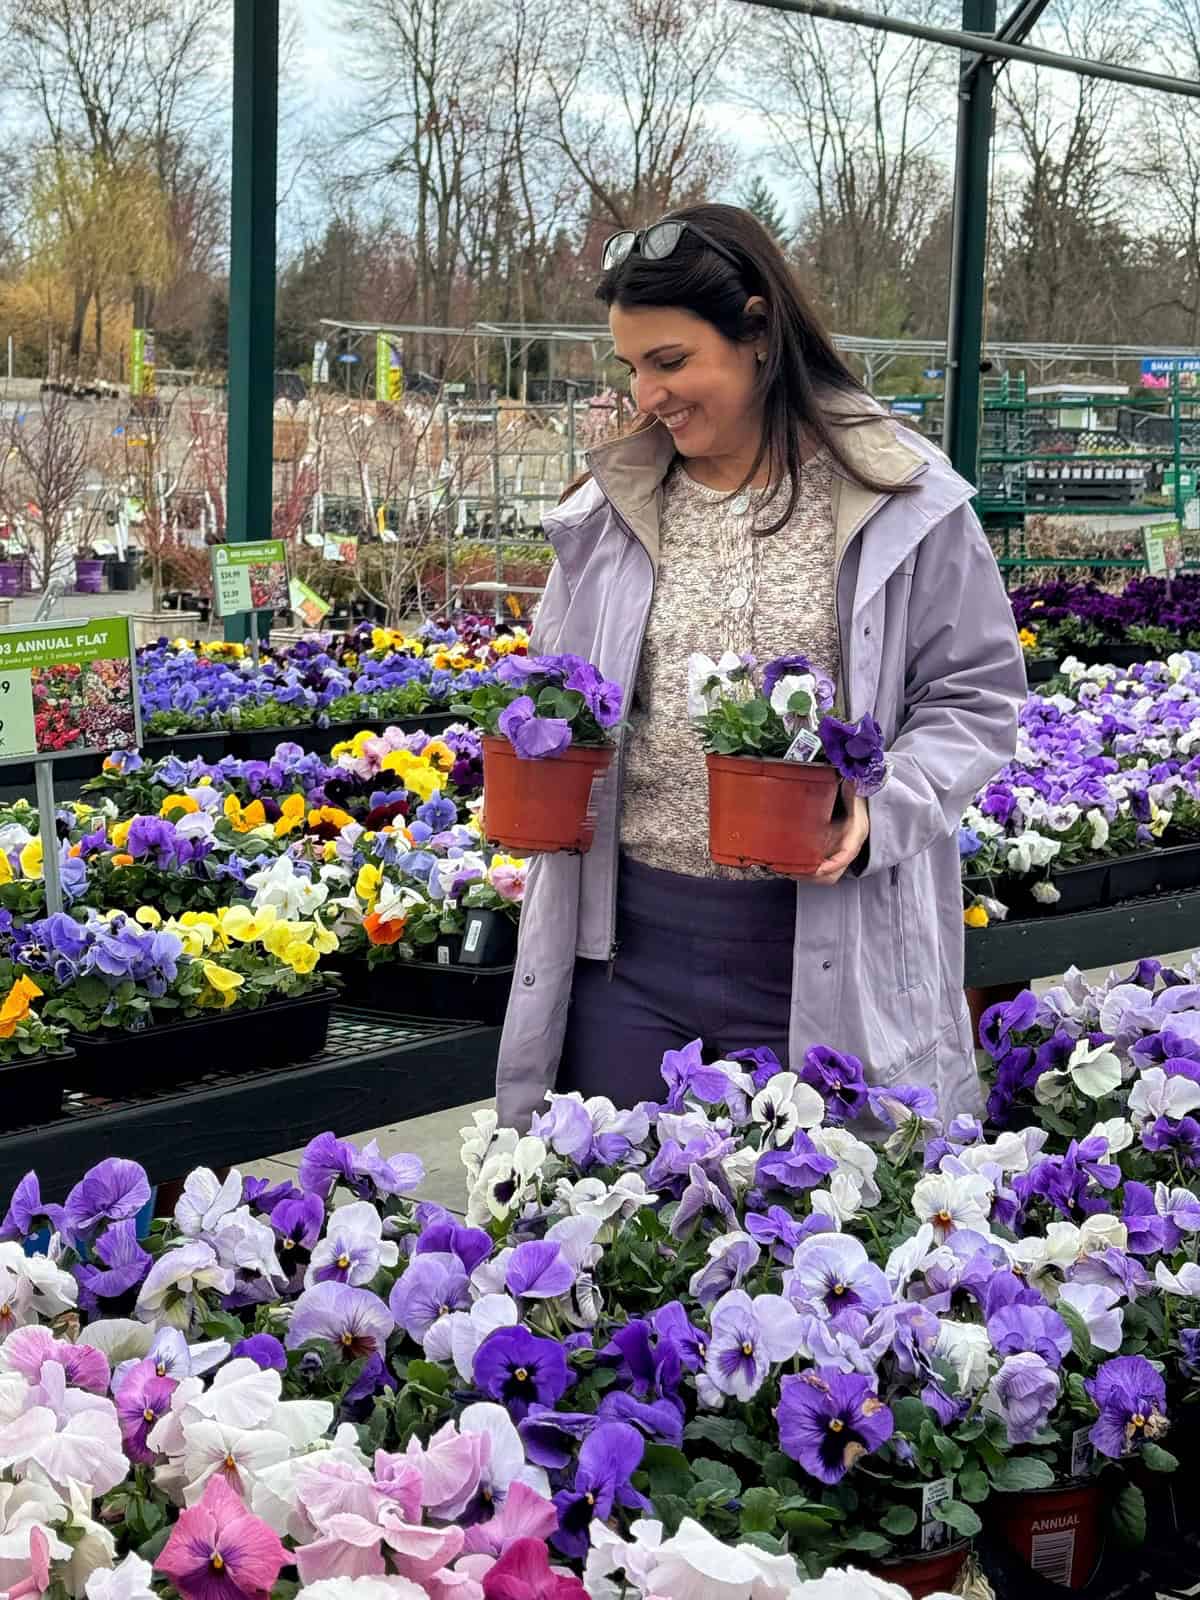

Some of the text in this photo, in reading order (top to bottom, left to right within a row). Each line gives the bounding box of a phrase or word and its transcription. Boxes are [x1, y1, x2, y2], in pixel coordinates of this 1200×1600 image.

[16, 637, 73, 653] ANNUAL
[76, 633, 108, 646] FLAT
[1031, 1514, 1080, 1531] ANNUAL
